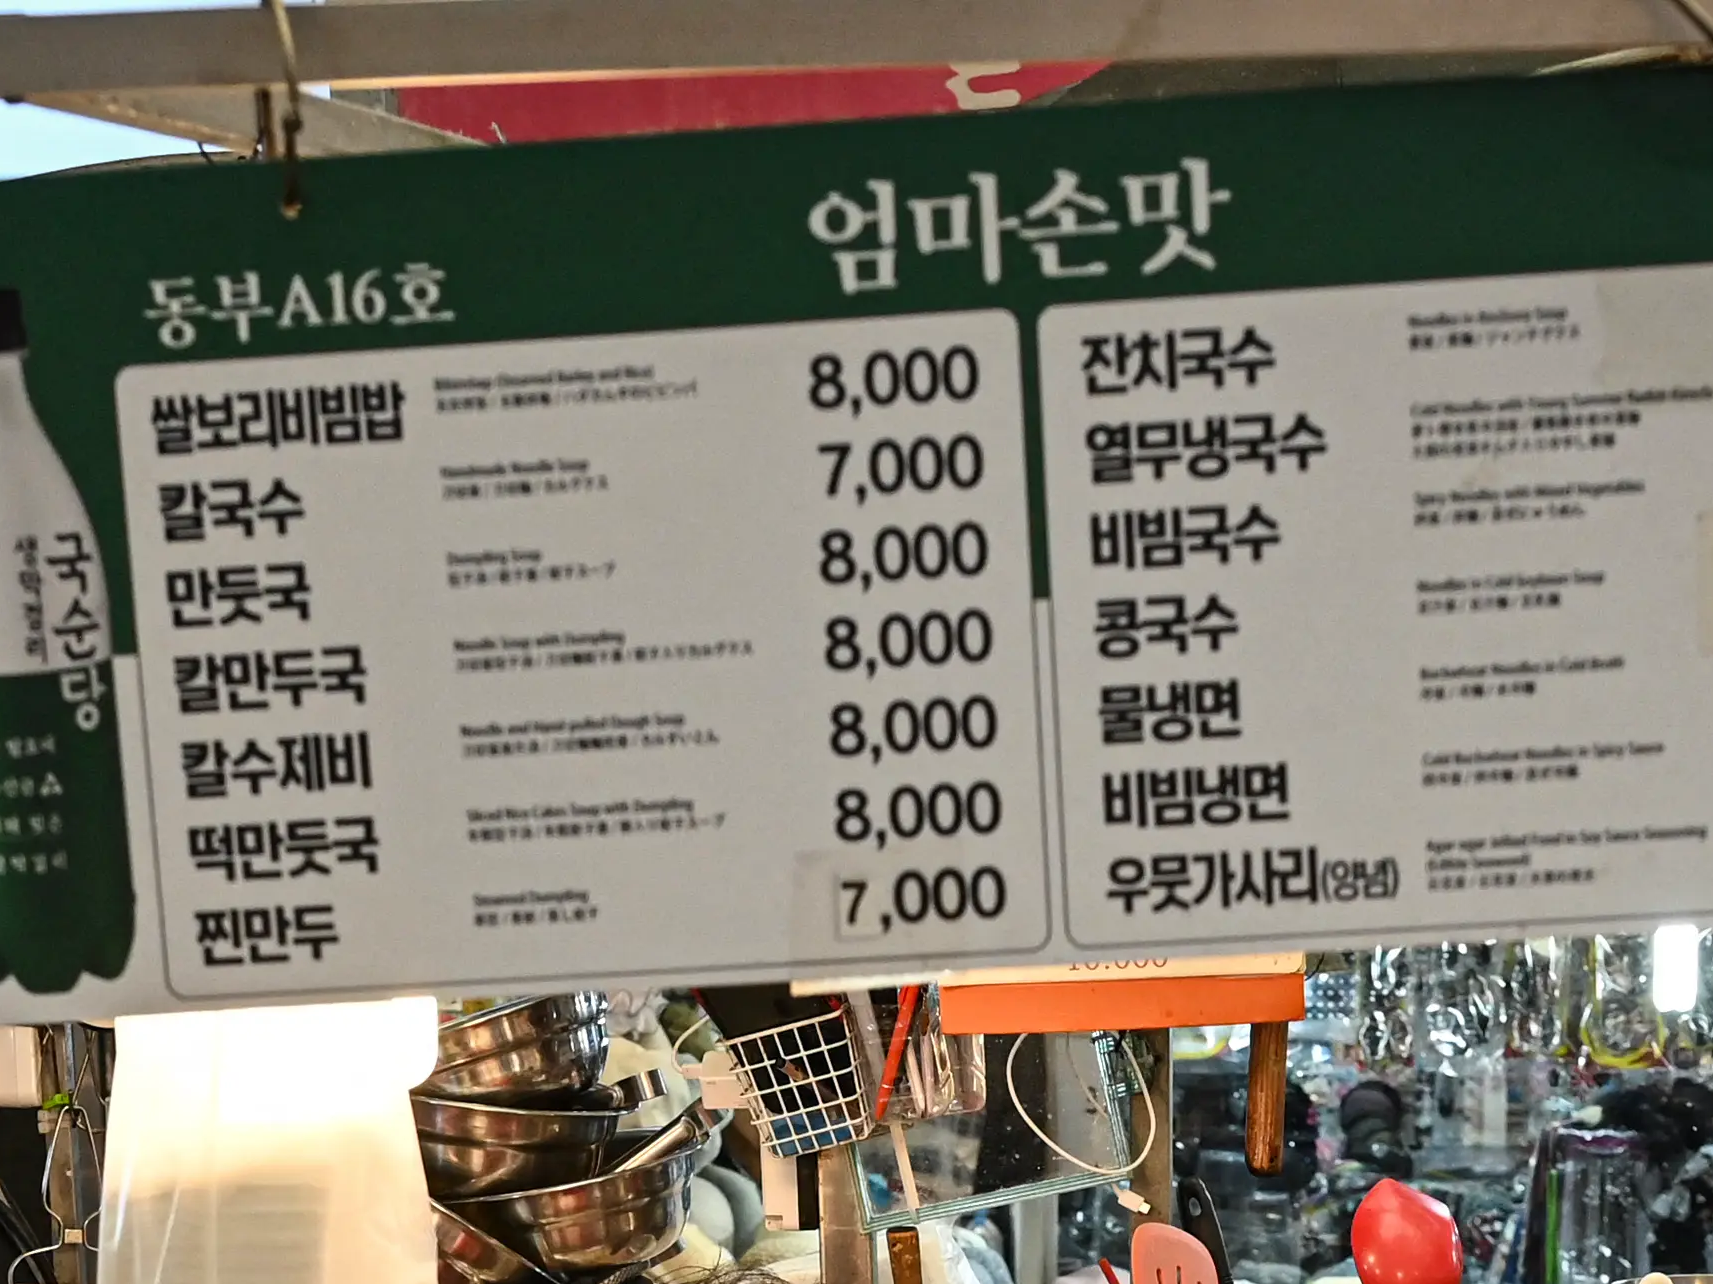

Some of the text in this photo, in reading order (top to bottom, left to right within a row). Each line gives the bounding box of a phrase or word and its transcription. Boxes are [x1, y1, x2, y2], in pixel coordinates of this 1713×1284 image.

[807, 158, 1231, 295] 엄마손맛
[144, 262, 455, 348] 동부A16호
[807, 345, 979, 416] 8,000
[1081, 327, 1276, 395] 잔치국수
[151, 381, 406, 455] 쌀보리비빔밥
[1086, 414, 1328, 484] 열무냉국수
[817, 434, 983, 504] 7,000
[158, 478, 306, 541] 칼국수
[1090, 504, 1281, 570] 비빔국수
[817, 520, 988, 592] 8,000
[45, 533, 108, 732] 국순당
[823, 608, 993, 680] 8,000
[1094, 595, 1240, 661] 콩국수
[174, 646, 367, 713] 칼만두국
[1098, 678, 1242, 744] 물냉면
[181, 731, 370, 797] 칼수제비
[828, 694, 997, 765] 8,000
[833, 780, 1002, 851] 8,000
[1103, 761, 1291, 828] 비빔냉면
[839, 866, 1006, 935] 7,000
[195, 906, 340, 967] 찐만두
